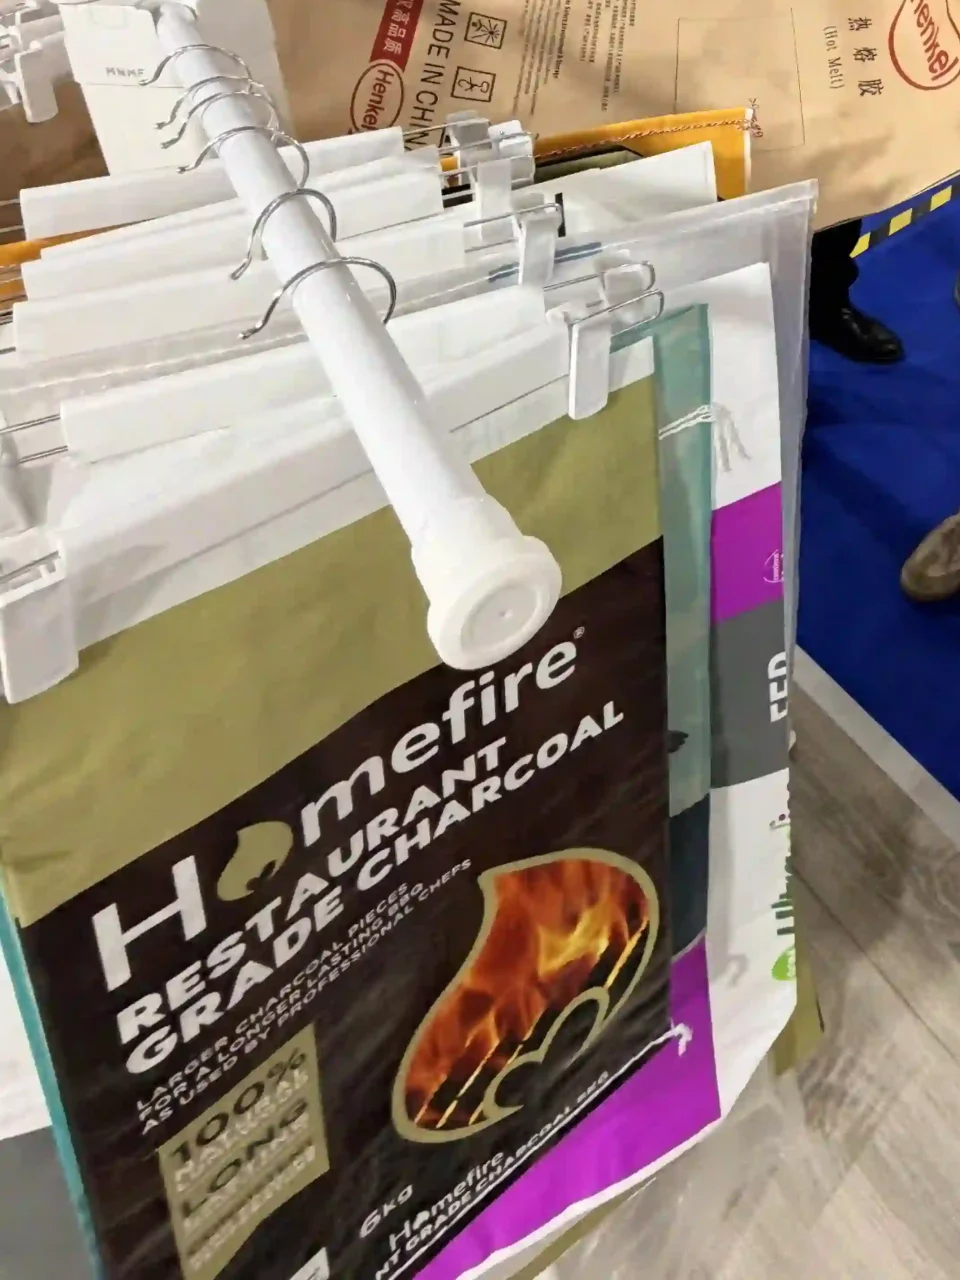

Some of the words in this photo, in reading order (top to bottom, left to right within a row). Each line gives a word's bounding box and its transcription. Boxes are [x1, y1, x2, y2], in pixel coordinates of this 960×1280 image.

[361, 70, 395, 134] Henkel
[405, 90, 439, 151] CHIN
[420, 62, 446, 85] IN
[116, 737, 506, 1045] RESTAURANT
[126, 885, 344, 1073] GRADE
[357, 700, 624, 891] CHARCOAL
[137, 1036, 229, 1111] LARGER
[235, 940, 344, 1034] CHARCOAL
[348, 882, 409, 938] PIECES
[138, 1081, 188, 1122] FOR
[197, 1066, 211, 1081] A
[222, 988, 302, 1061] LONGER
[307, 916, 384, 988] LASTING
[142, 1106, 174, 1135] AS
[180, 1056, 238, 1106] USED
[244, 1028, 271, 1054] BY
[277, 904, 414, 1027] PROFESSIONAL
[418, 858, 472, 901] CHEFS
[170, 1048, 307, 1162] 100%
[181, 1099, 307, 1217] LONG
[360, 1184, 413, 1238] 6kg
[406, 1191, 471, 1252] GRADE
[475, 1106, 570, 1192] CHARCOAL
